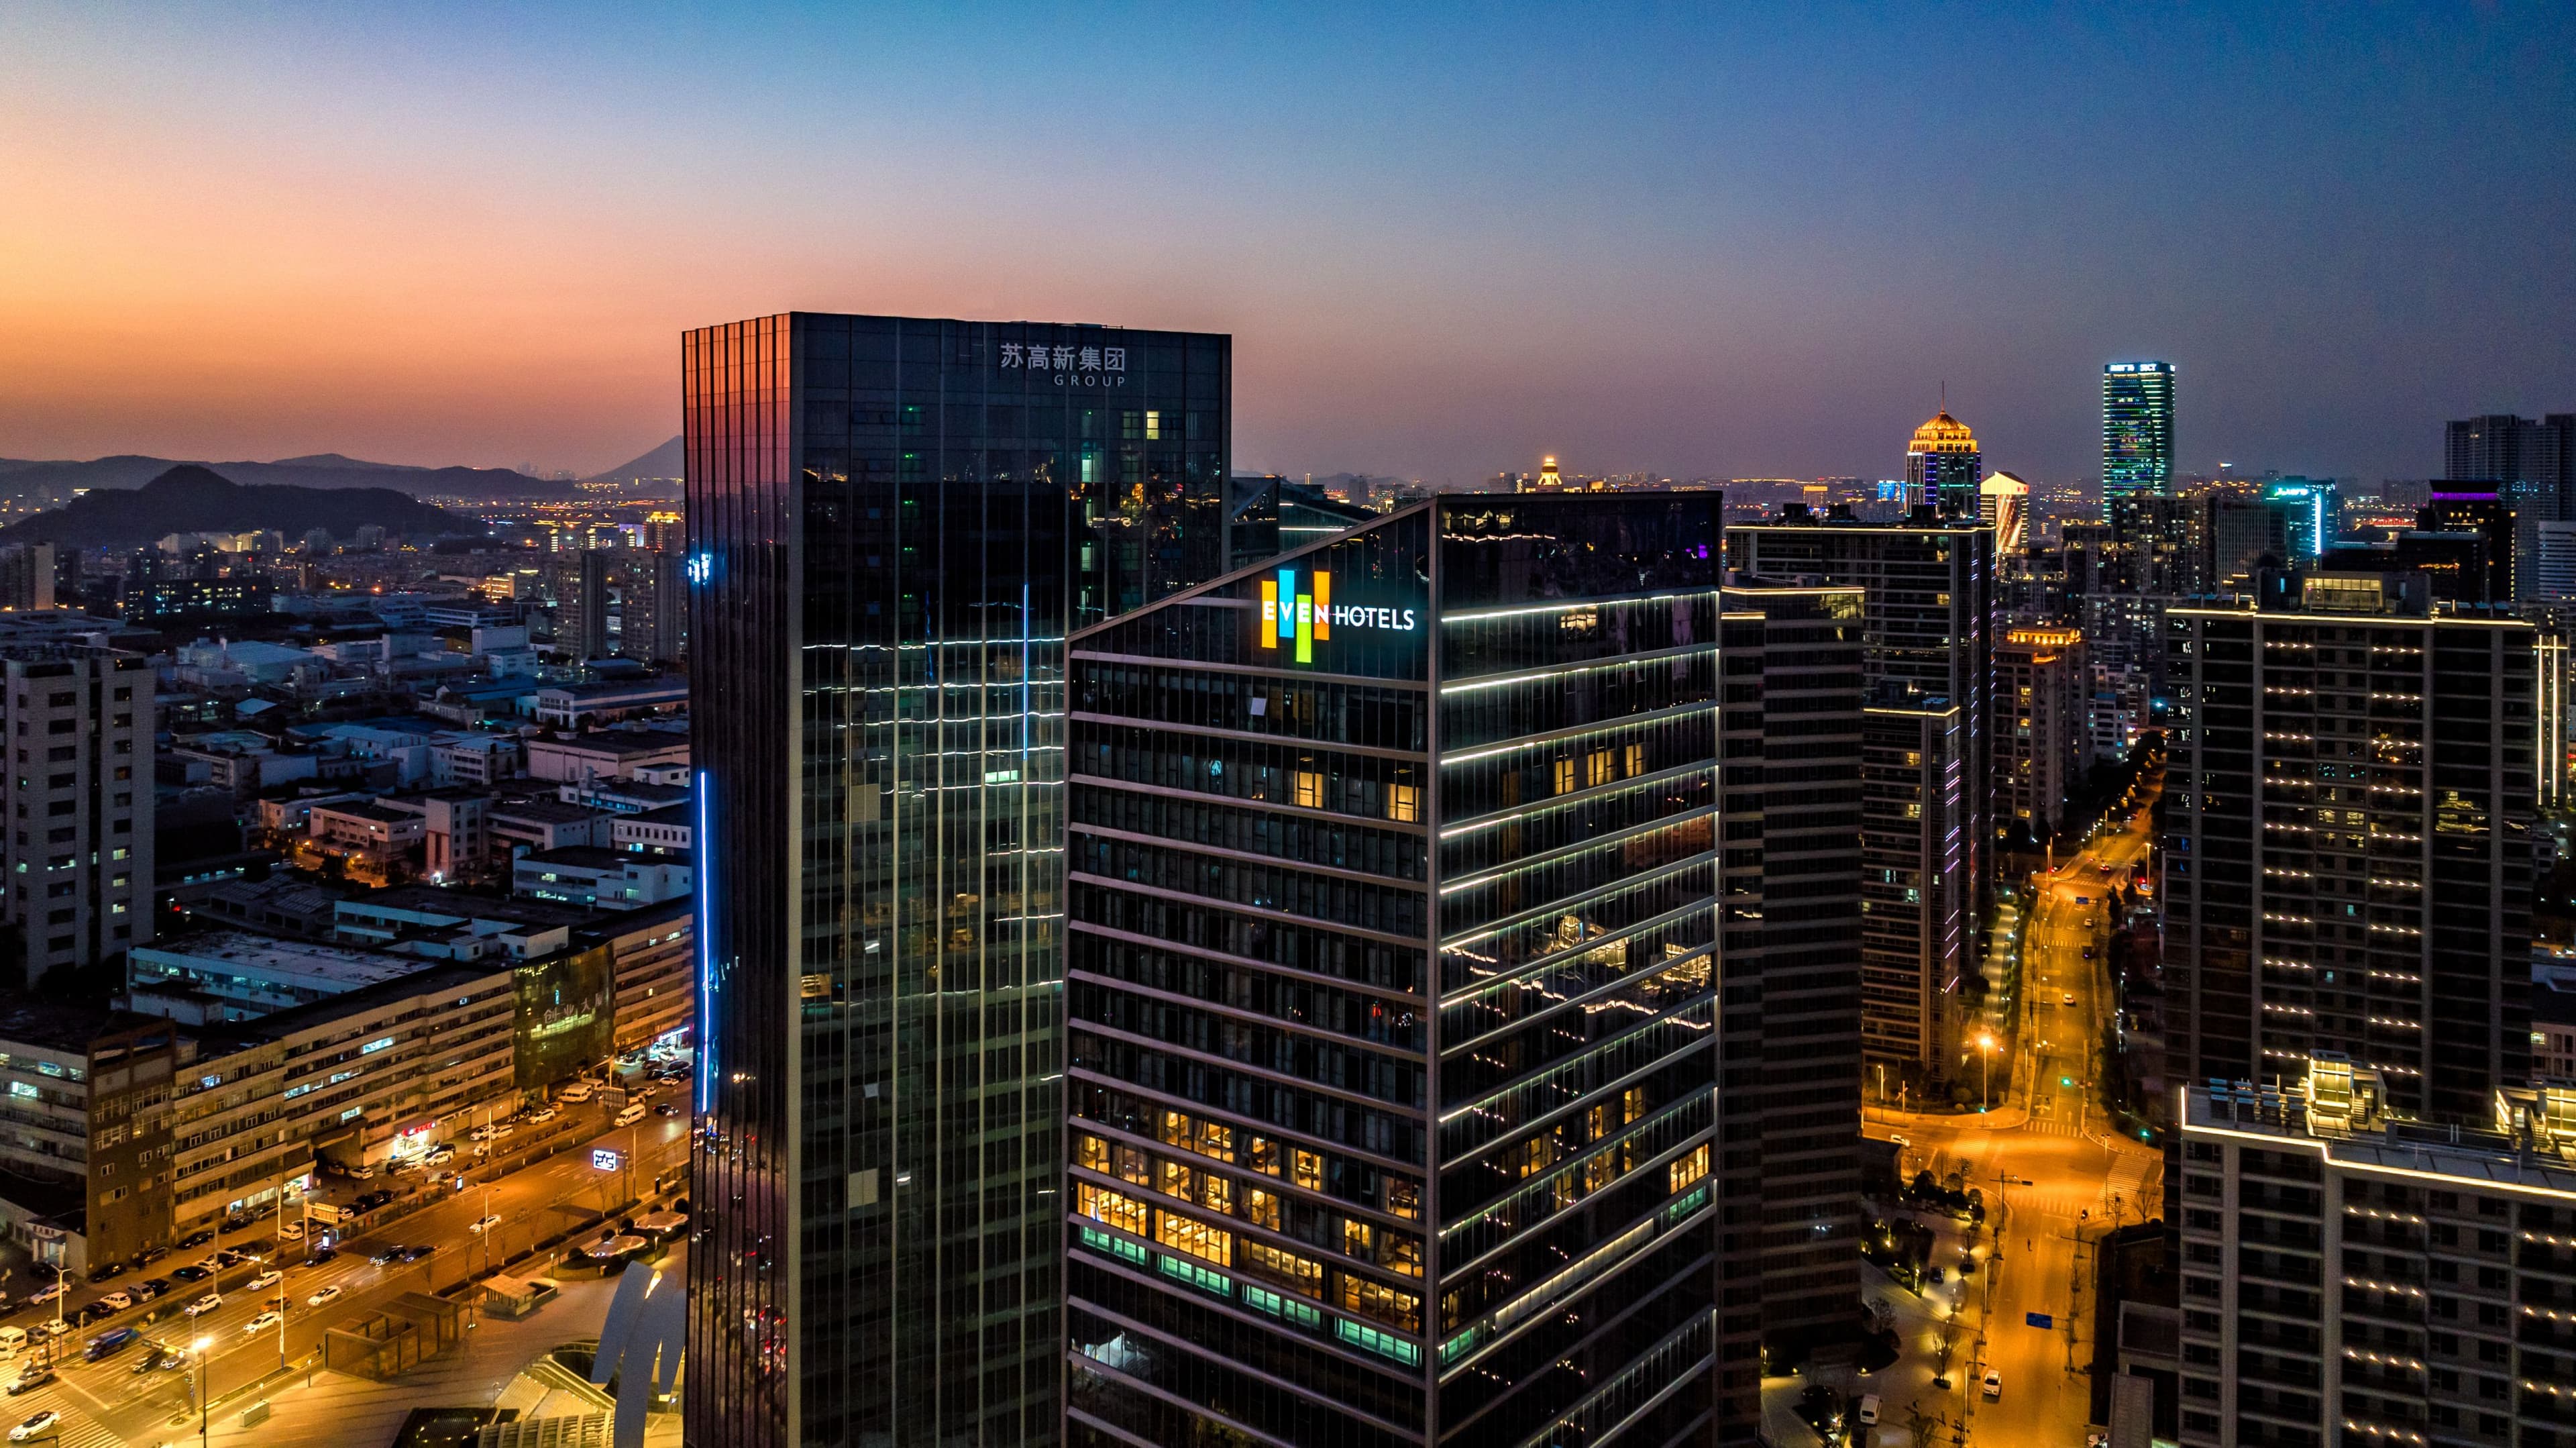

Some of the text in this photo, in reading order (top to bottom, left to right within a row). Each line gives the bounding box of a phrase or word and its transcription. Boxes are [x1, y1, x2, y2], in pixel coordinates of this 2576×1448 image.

[1000, 342, 1125, 372] 苏高新集团
[1054, 374, 1125, 387] GROUP
[1263, 601, 1415, 631] EVEN HOTELS
